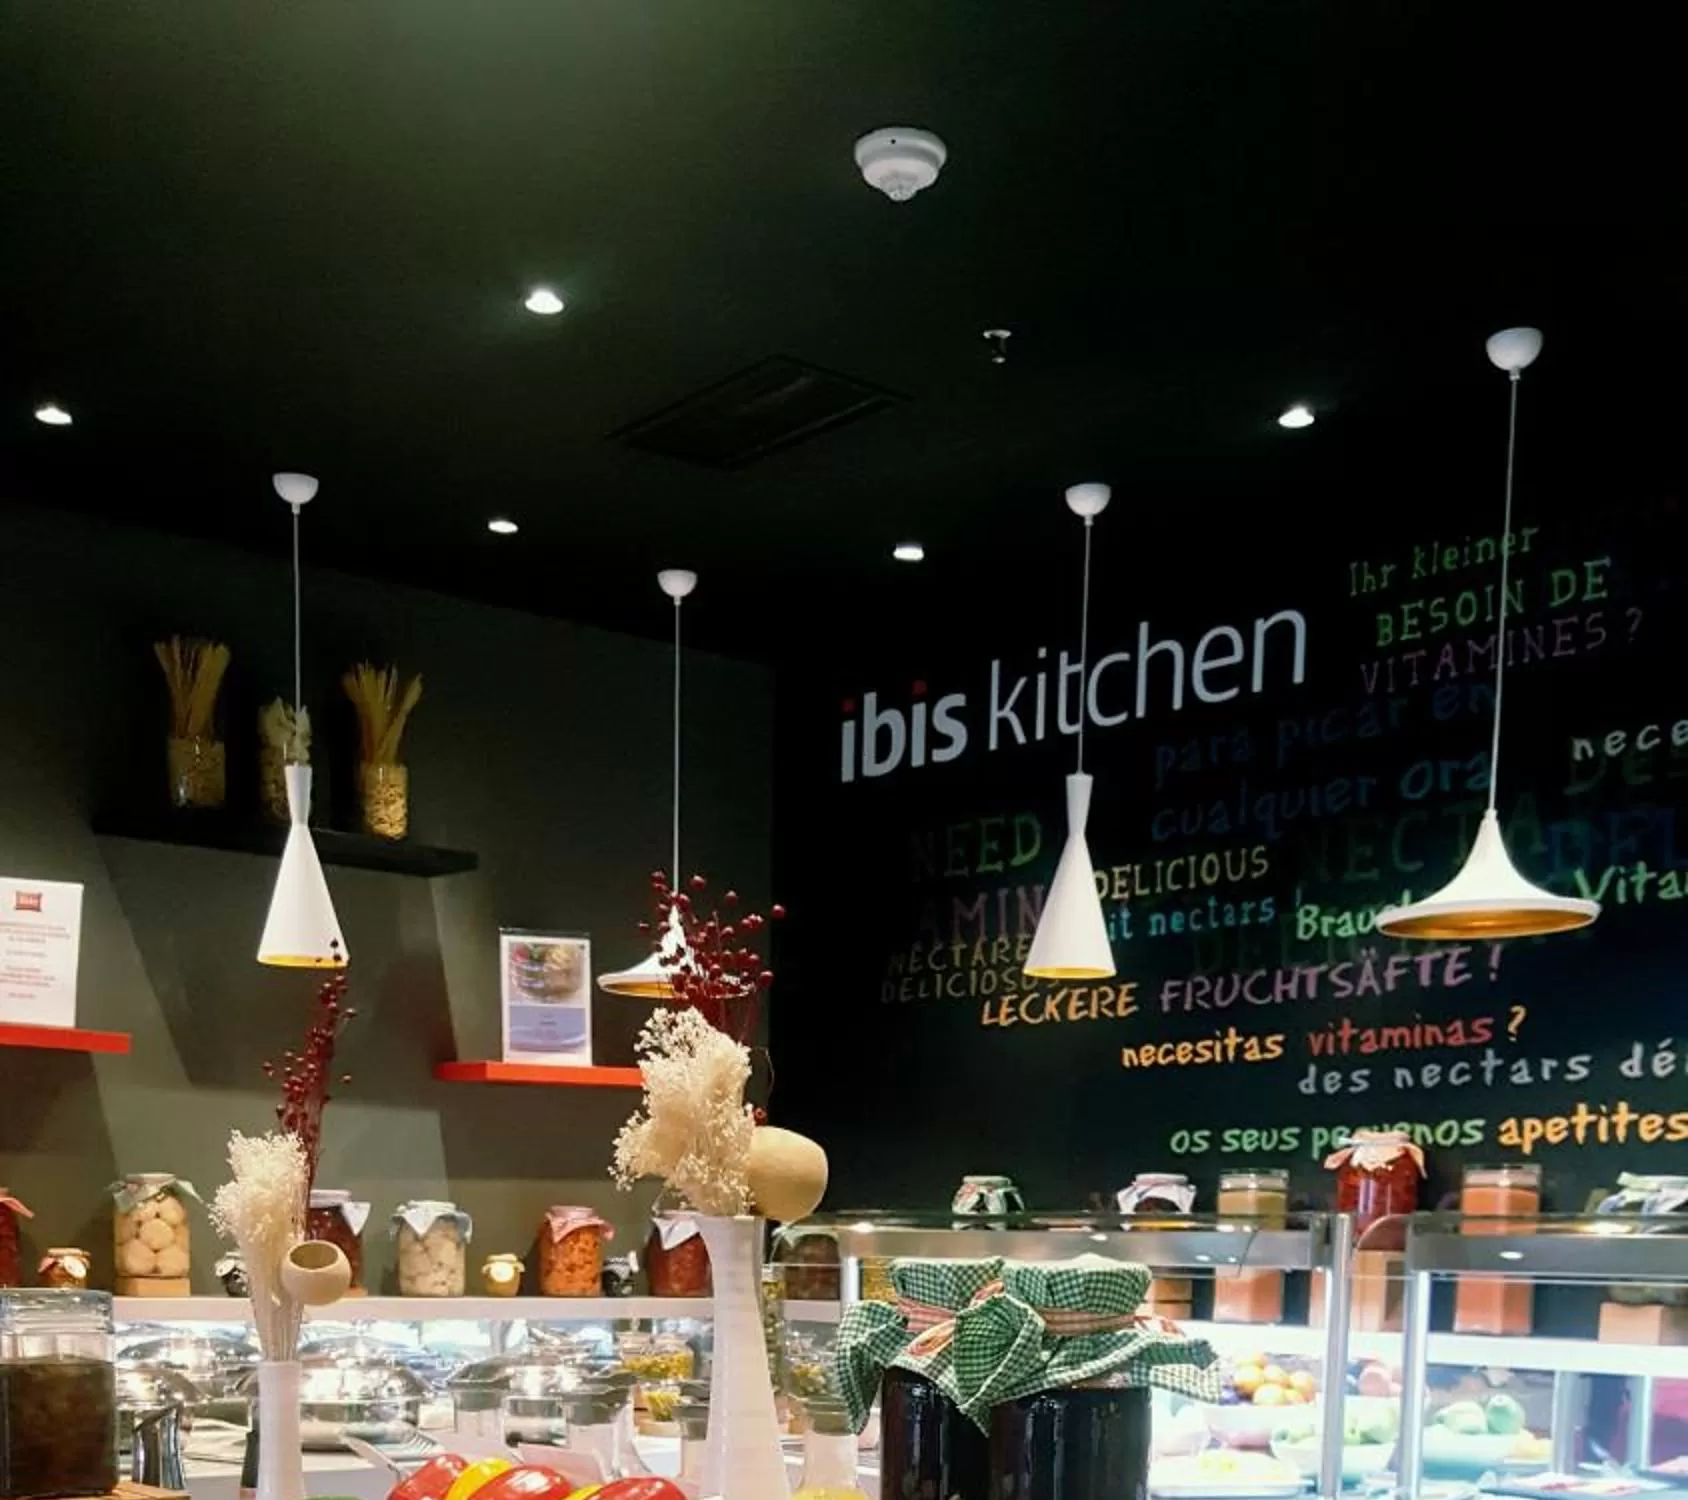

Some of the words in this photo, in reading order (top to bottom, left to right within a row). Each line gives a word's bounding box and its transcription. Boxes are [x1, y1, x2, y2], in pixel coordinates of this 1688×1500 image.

[1350, 561, 1397, 597] Ihr
[1411, 526, 1540, 580] kleiner
[1376, 579, 1525, 647] BESOIN
[1549, 556, 1611, 606] DE
[1360, 612, 1607, 694] VITAMINES
[840, 681, 967, 783] ibis
[987, 607, 1307, 751] kitchen
[909, 812, 1042, 882] NEED
[1093, 845, 1269, 901] DELICIOUS
[1148, 895, 1276, 938] nectars
[1296, 888, 1412, 942] Brau
[1573, 860, 1688, 904] Vita
[880, 966, 1061, 1004] DELICIOS
[980, 982, 1140, 1028] LECKERE
[1158, 946, 1473, 1013] FRUCHTSÄFTE
[1488, 944, 1502, 982] !
[1122, 1026, 1285, 1070] necesitas
[1308, 1012, 1494, 1057] vitaminas
[1507, 1004, 1528, 1043] ?
[1299, 1061, 1371, 1096] des
[1394, 1047, 1593, 1091] nectars
[1619, 1036, 1688, 1079] dé
[1170, 1127, 1212, 1155] os
[1221, 1122, 1301, 1155] seus
[1311, 1118, 1487, 1161] penos
[1498, 1100, 1688, 1156] apetites
